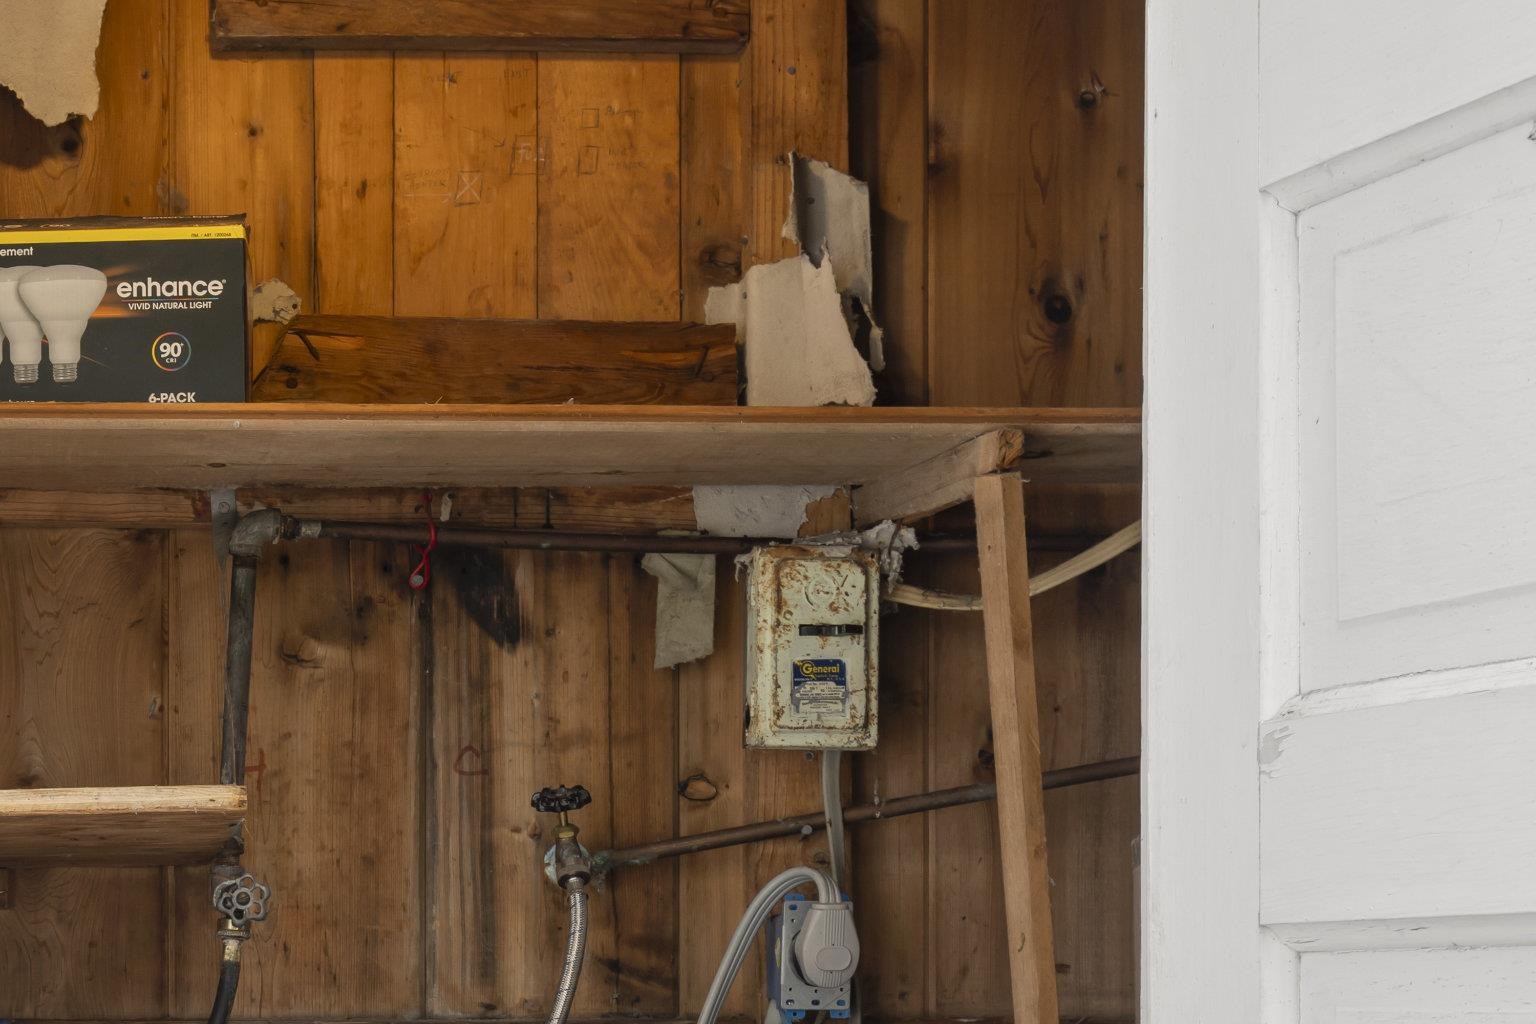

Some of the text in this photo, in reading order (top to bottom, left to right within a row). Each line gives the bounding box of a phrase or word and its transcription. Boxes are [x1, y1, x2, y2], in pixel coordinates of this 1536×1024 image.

[127, 301, 213, 311] VIVID NATURAL LIGHT
[148, 391, 197, 403] 6-PACK
